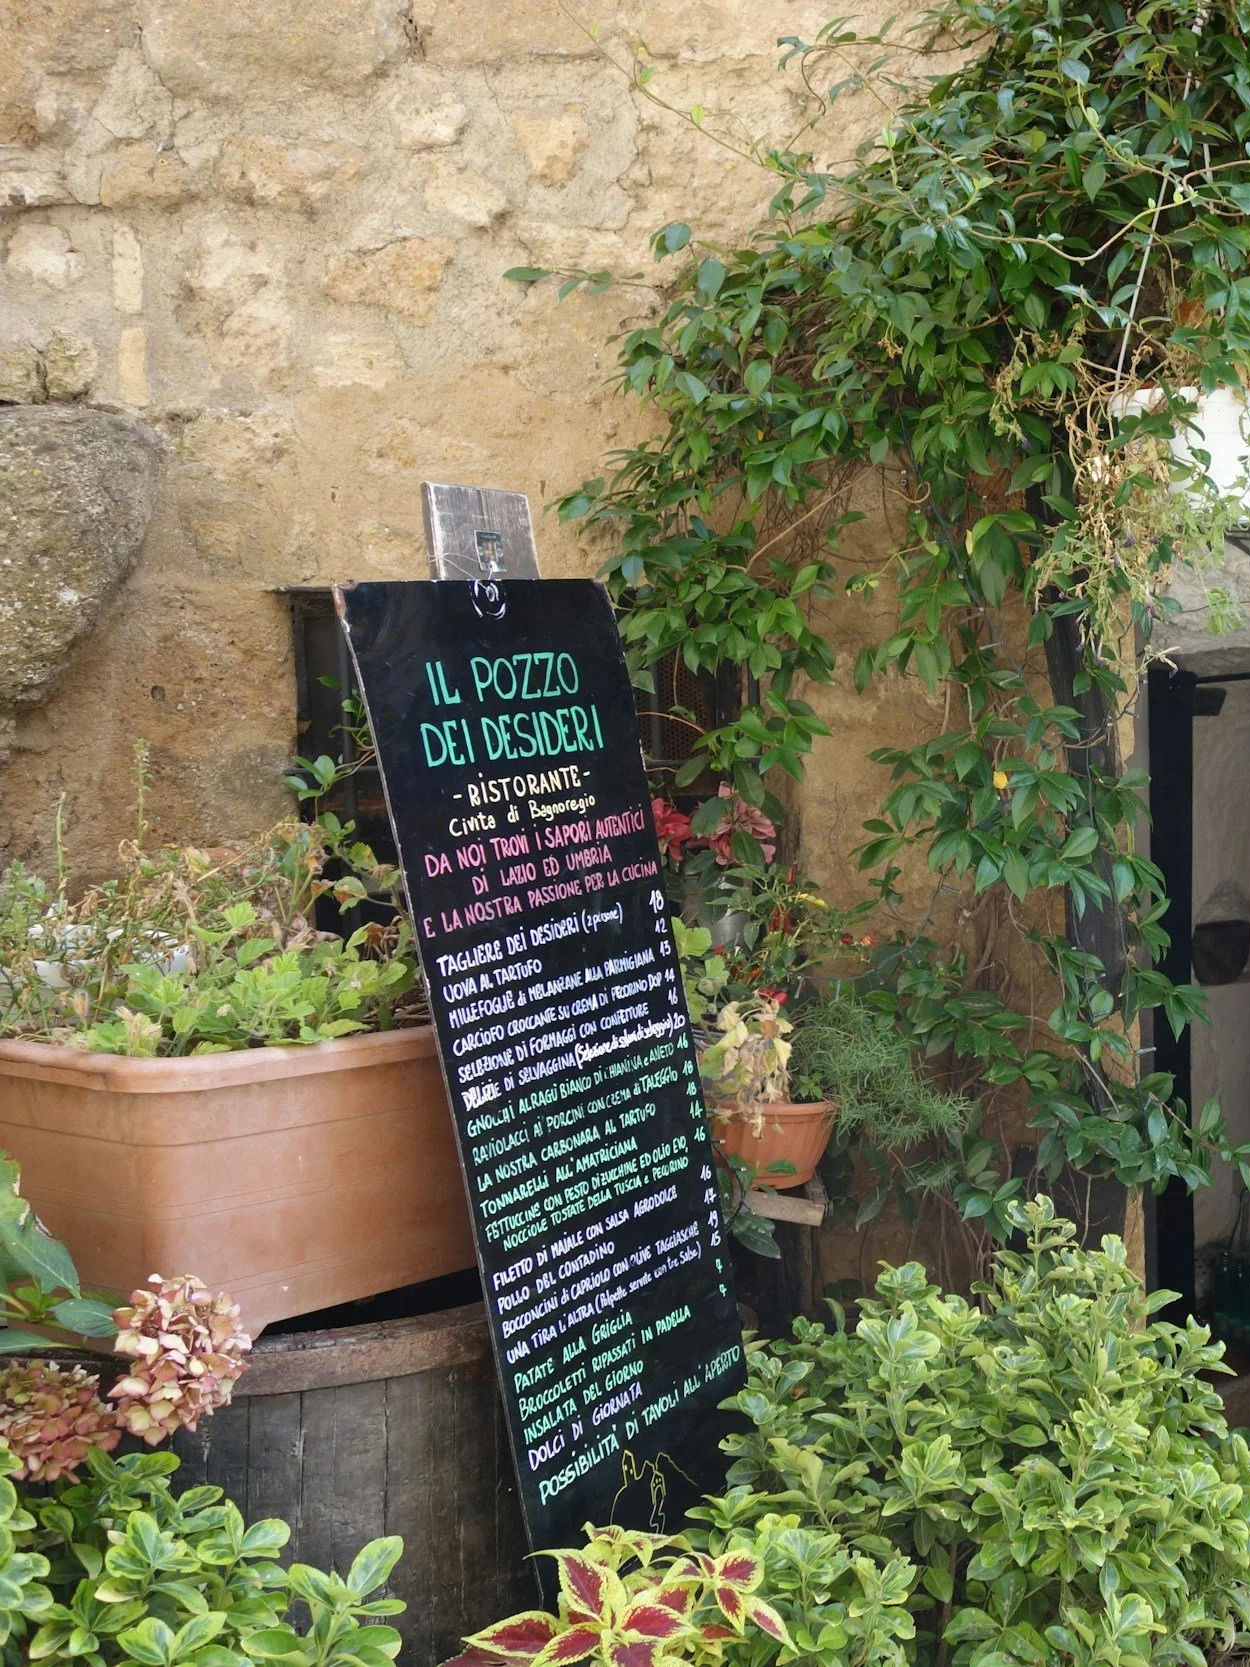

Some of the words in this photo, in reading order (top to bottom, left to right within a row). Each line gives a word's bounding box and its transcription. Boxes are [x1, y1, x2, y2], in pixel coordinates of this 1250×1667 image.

[426, 661, 461, 705] IL
[470, 652, 578, 702] POZZO
[420, 719, 474, 767] DEI
[481, 705, 603, 760] DESIDERI
[425, 853, 452, 877] DA
[456, 838, 486, 869] NOI
[489, 828, 529, 860] TROVI
[545, 815, 592, 848] SAPORI
[596, 804, 644, 839] AUTENTICI
[449, 812, 496, 836] Civita
[508, 805, 519, 823] di
[528, 793, 595, 821] Bagnoregio
[423, 917, 435, 938] E
[441, 909, 463, 932] LA
[464, 896, 522, 926] NOSTRA
[527, 879, 582, 908] PASSIONE
[585, 873, 604, 892] PER
[607, 870, 619, 886] LA
[622, 857, 657, 881] CUCINA
[472, 868, 489, 895] DI
[500, 863, 536, 886] LAZIO
[543, 857, 559, 876] ED
[566, 842, 612, 870] UMBRIA
[436, 940, 503, 976] TAGLIERE
[506, 926, 527, 955] DEI
[530, 912, 579, 946] DESIDERI
[649, 890, 664, 913] 18
[443, 977, 478, 1003] UOVA
[480, 974, 493, 992] AL
[493, 959, 542, 985] TARTUFO
[654, 918, 667, 934] 12
[449, 990, 515, 1028] MILLEFOGLIE
[517, 991, 527, 1006] di
[528, 971, 583, 1001] MELANZANE
[585, 966, 603, 983] ALLA
[604, 948, 655, 977] PARMIGIANA
[660, 940, 670, 956] 13
[453, 1025, 504, 1056] CARCIOFO
[507, 1007, 557, 1036] CROCCANTE
[558, 1005, 570, 1020] SU
[571, 994, 598, 1015] CREMA
[599, 988, 608, 1006] DI
[611, 979, 648, 1001] PECORINO
[665, 968, 675, 982] 14
[458, 1048, 515, 1083] SELEZIONE
[515, 1041, 528, 1061] DI
[529, 1024, 576, 1056] FORMAGGI
[579, 1021, 597, 1038] CON
[600, 1002, 649, 1030] CONFETTURE
[668, 987, 678, 1005] 16
[504, 1072, 514, 1091] DI
[518, 1053, 576, 1085] SELVAGGINA
[674, 1012, 685, 1029] 20
[560, 1077, 591, 1099] BIANCO
[650, 1042, 674, 1062] ANETO
[677, 1032, 688, 1050] 16
[473, 1122, 529, 1165] RAVIOLACCI
[546, 1104, 585, 1132] PORCINI
[639, 1066, 677, 1093] TALEGGIO
[682, 1060, 694, 1076] 18
[477, 1173, 493, 1192] LA
[495, 1152, 537, 1183] NOSTRA
[541, 1126, 600, 1161] CARBONARA
[605, 1119, 616, 1135] AL
[686, 1082, 696, 1096] 18
[480, 1170, 549, 1218] TONNARELLI
[690, 1100, 702, 1118] 14
[485, 1202, 541, 1242] FETTUCCINE
[544, 1194, 563, 1211] CON
[564, 1181, 589, 1203] PESTO
[640, 1153, 651, 1168] ED
[653, 1143, 670, 1163] OLIO
[694, 1126, 706, 1141] 16
[493, 1257, 533, 1291] FILETTO
[536, 1245, 548, 1266] DI
[551, 1231, 584, 1259] MAIALE
[586, 1222, 603, 1240] CON
[605, 1209, 629, 1230] SALSA
[634, 1185, 677, 1218] AGRODOLCE
[700, 1165, 712, 1181] 16
[504, 1218, 548, 1251] NOCCIOLE
[550, 1199, 585, 1225] TOSTATE
[587, 1189, 612, 1209] DELLA
[614, 1175, 642, 1195] TUSCIA
[652, 1157, 688, 1181] PECORINO
[497, 1286, 530, 1314] POLLO
[536, 1272, 556, 1293] DEL
[558, 1242, 614, 1279] CONTADINO
[704, 1188, 716, 1204] 17
[502, 1292, 558, 1338] BOCCONCINI
[561, 1288, 570, 1305] di
[571, 1268, 610, 1300] CAPRIOLO
[613, 1258, 629, 1277] CON
[655, 1221, 699, 1255] TAGGIASCHE
[708, 1210, 718, 1228] 19
[507, 1341, 530, 1364] UNA
[531, 1326, 557, 1348] TIRA
[667, 1257, 679, 1269] tre
[710, 1231, 720, 1246] 15
[514, 1358, 554, 1393] PATATE
[563, 1336, 586, 1364] ALLA
[592, 1309, 632, 1344] GRIGLIA
[716, 1259, 722, 1273] 7
[519, 1362, 586, 1421] BROCCOLETTI
[592, 1333, 635, 1372] RIPASSATI
[641, 1327, 653, 1344] IN
[656, 1305, 691, 1335] PADELLA
[719, 1284, 726, 1297] 7
[524, 1398, 577, 1444] INSALATA
[583, 1382, 602, 1404] DEL
[606, 1360, 643, 1391] GIORNO
[528, 1429, 565, 1471] DOLCI
[572, 1415, 583, 1440] DI
[592, 1382, 642, 1426] GIORNATA
[626, 1411, 639, 1439] DI
[642, 1381, 679, 1426] TAVOLI
